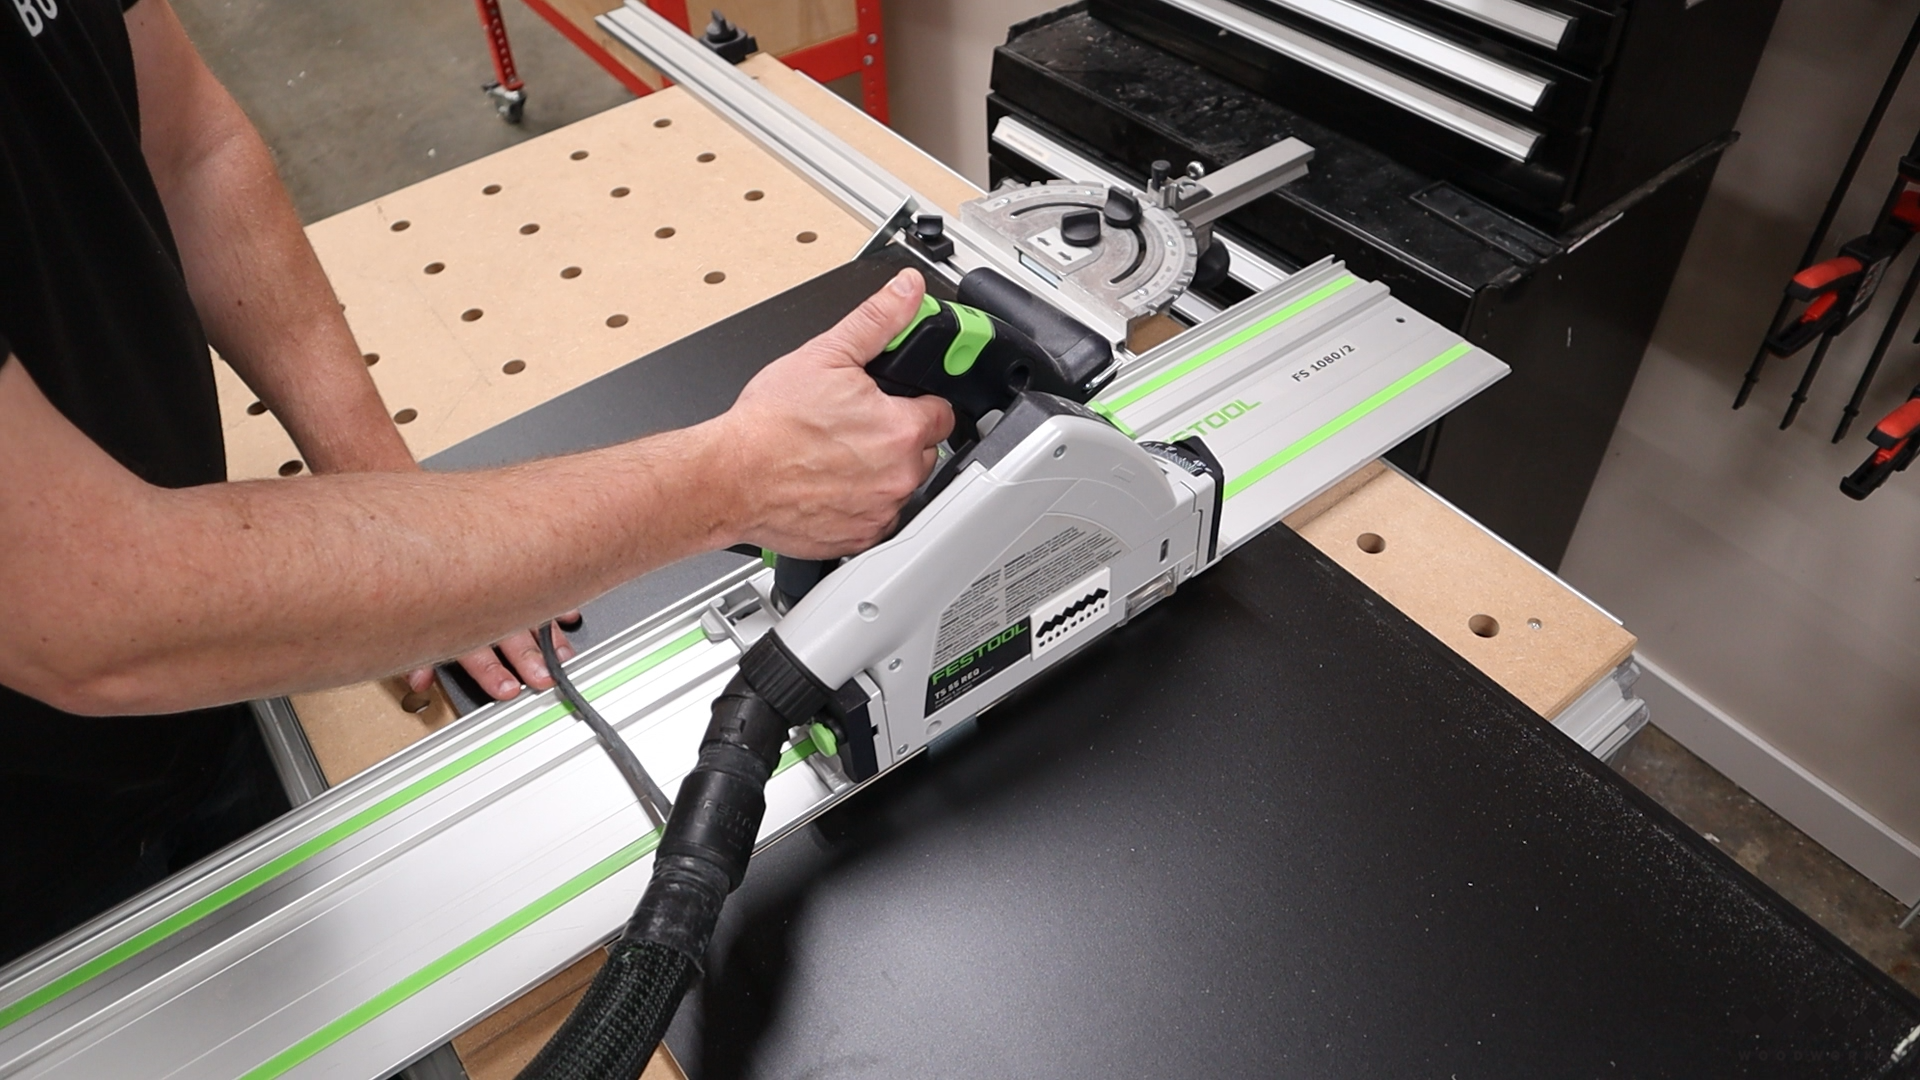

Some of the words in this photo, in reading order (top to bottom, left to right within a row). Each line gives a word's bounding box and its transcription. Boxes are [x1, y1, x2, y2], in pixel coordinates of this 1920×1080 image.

[1291, 369, 1310, 383] FS
[1309, 344, 1355, 373] 1080/2
[1163, 399, 1262, 443] STOOL
[932, 623, 1028, 686] FESTOOL
